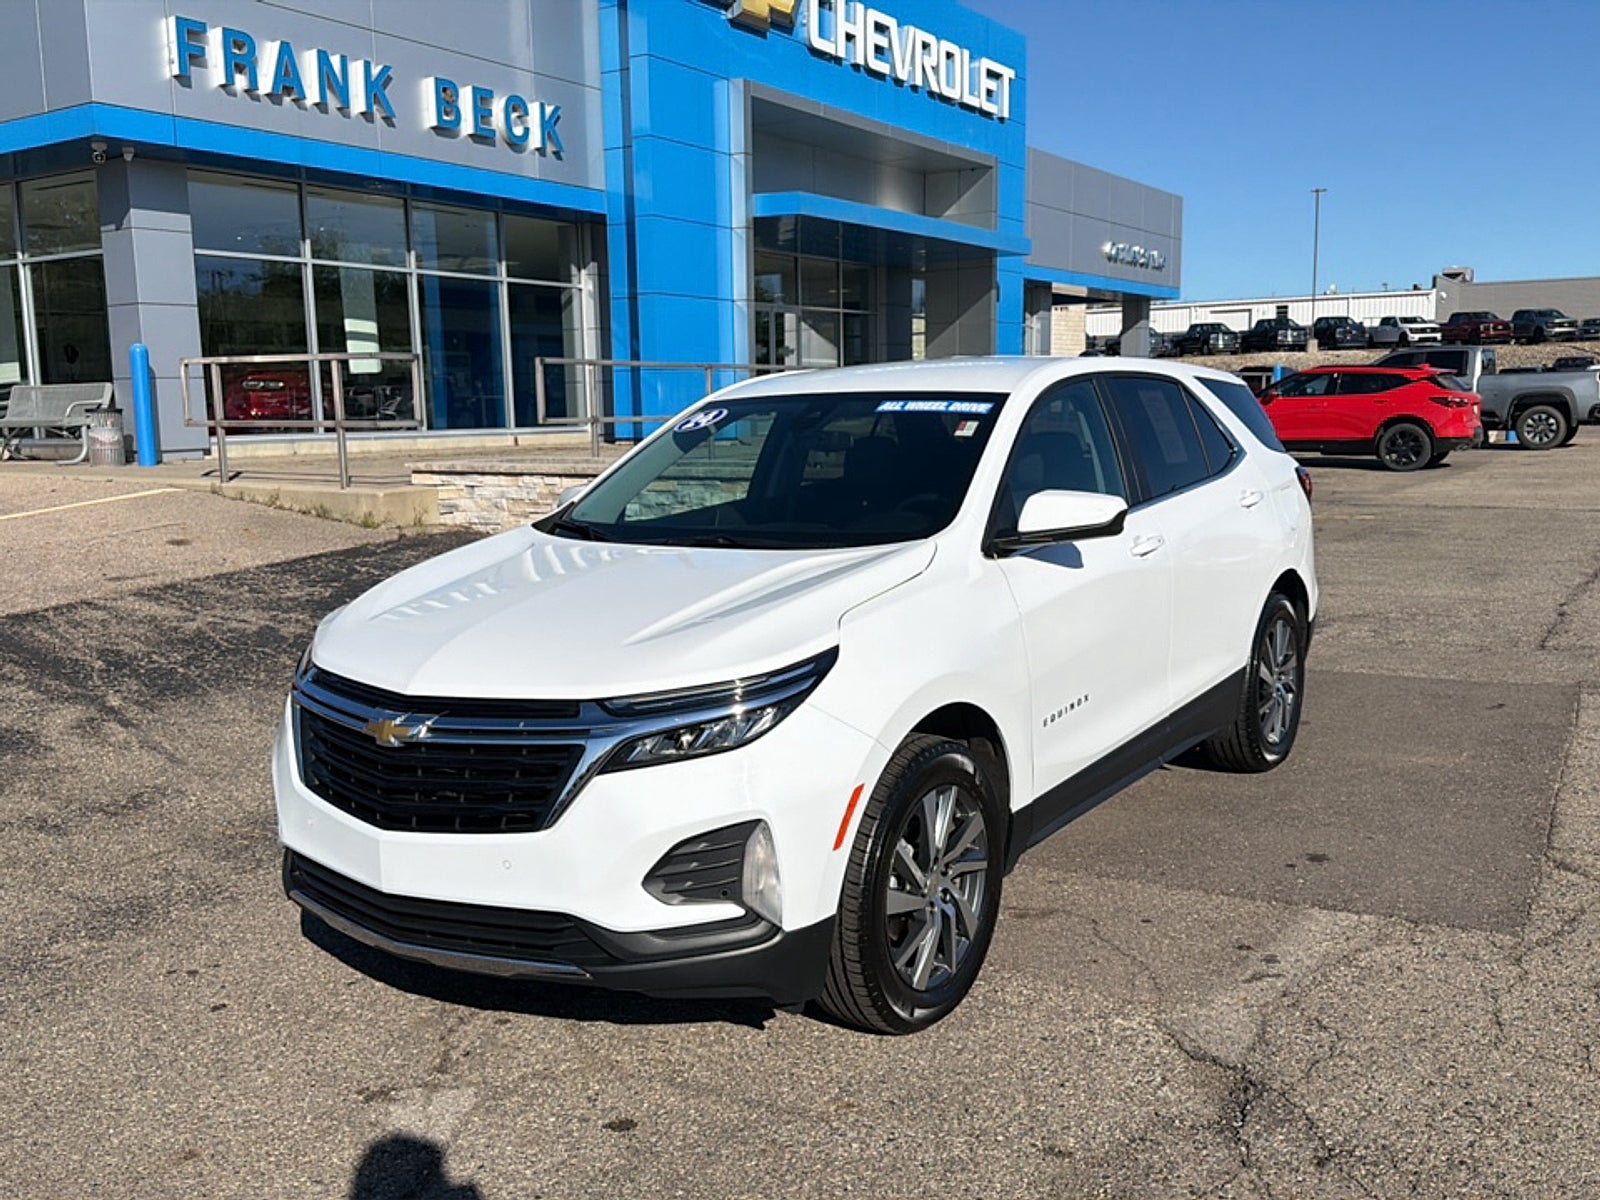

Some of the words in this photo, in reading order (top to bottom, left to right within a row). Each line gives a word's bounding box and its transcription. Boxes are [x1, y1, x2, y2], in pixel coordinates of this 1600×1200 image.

[171, 15, 396, 119] FRANK
[427, 76, 564, 153] BECK
[808, 0, 1015, 119] CHEVROLET
[876, 401, 904, 411] ALL
[904, 401, 948, 411] WHEEL
[948, 402, 994, 413] DRIVE
[1043, 693, 1090, 728] EQUINOX
